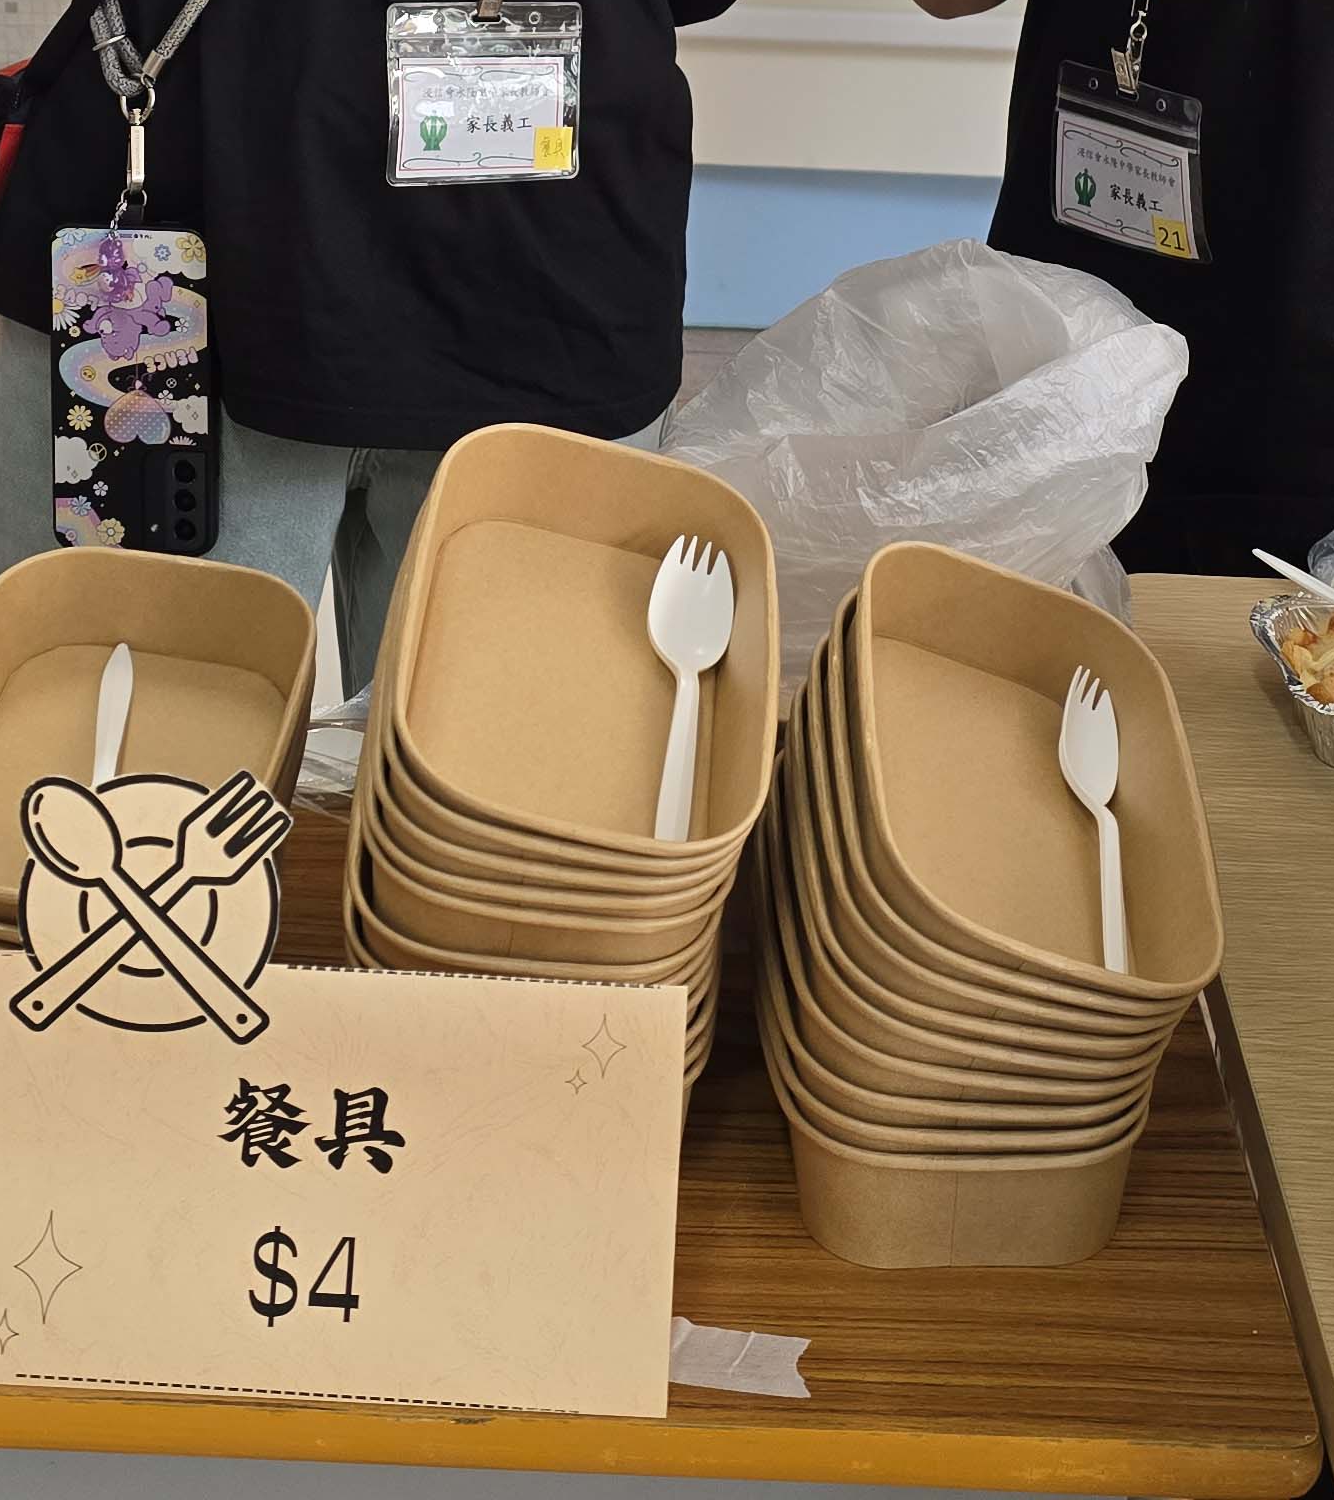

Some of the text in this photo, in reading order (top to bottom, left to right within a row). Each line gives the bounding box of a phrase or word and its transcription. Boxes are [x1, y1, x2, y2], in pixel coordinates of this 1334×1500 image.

[466, 113, 532, 133] 家長義工
[1110, 184, 1163, 213] 家長義工
[1158, 226, 1185, 251] 21
[144, 346, 199, 373] PEACE
[219, 1077, 405, 1175] 餐具
[248, 1225, 360, 1327] $4
